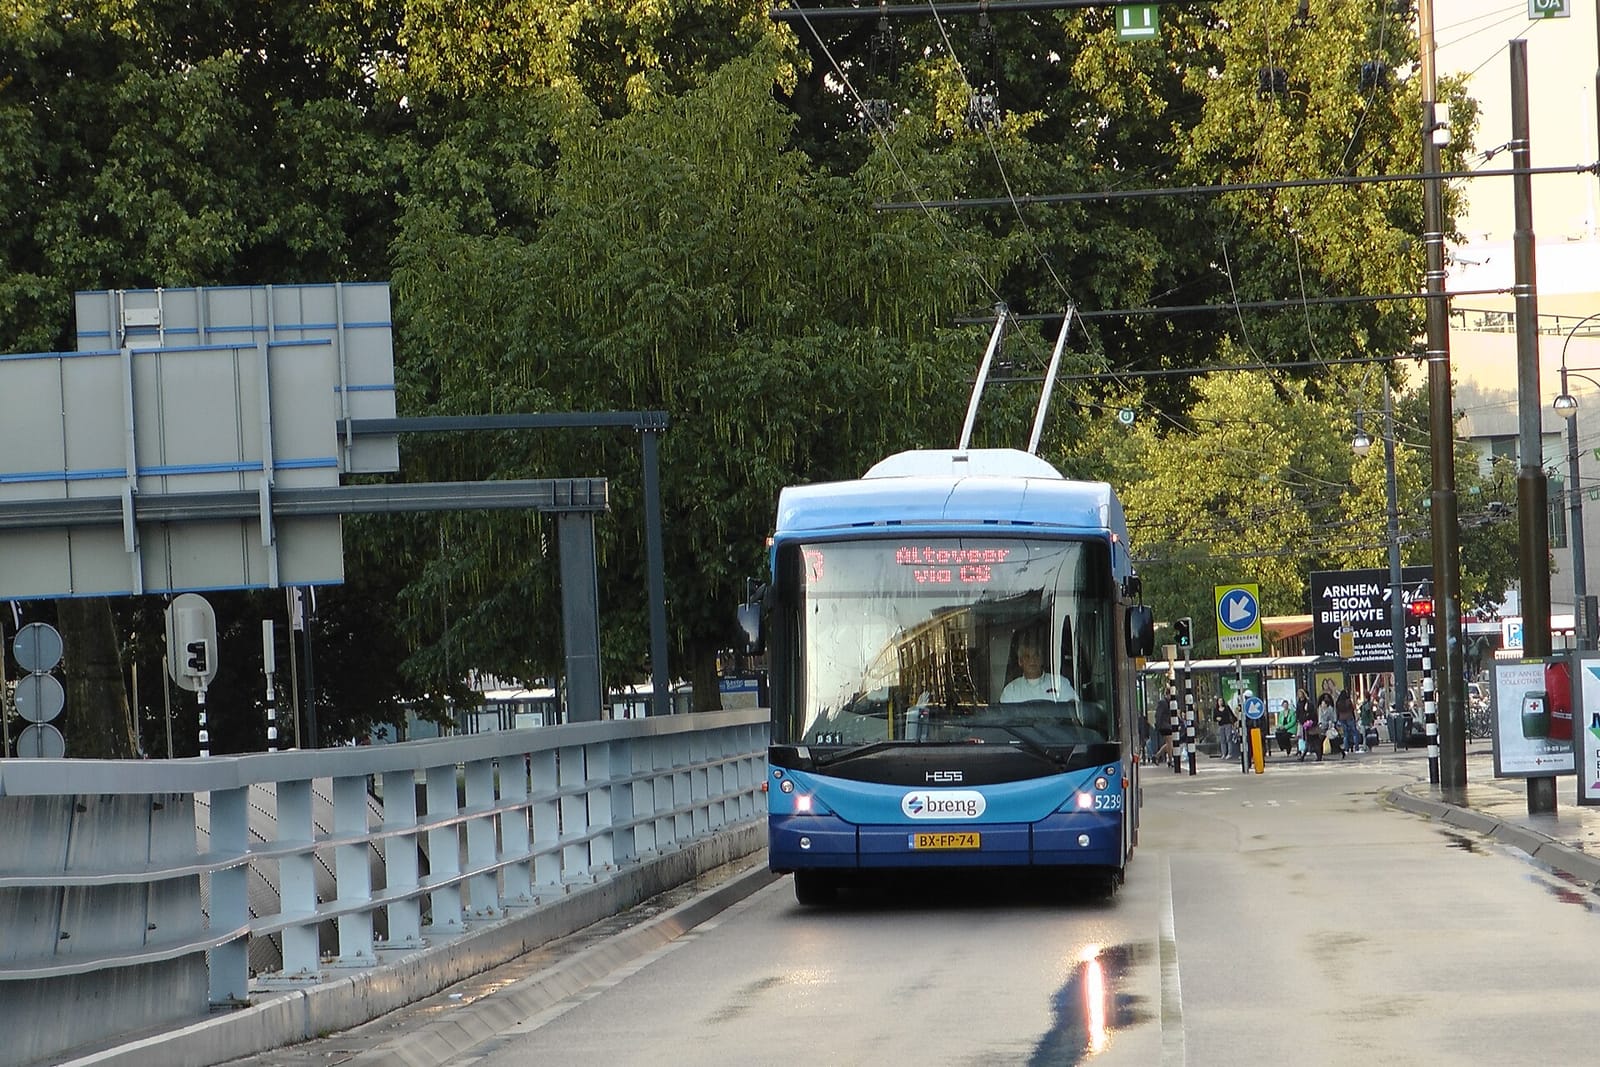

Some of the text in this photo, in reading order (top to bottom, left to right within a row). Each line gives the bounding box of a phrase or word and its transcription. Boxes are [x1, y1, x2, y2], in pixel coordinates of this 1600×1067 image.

[914, 566, 951, 584] via
[1322, 583, 1380, 598] ARNHEM
[1410, 625, 1416, 635] 3
[925, 771, 963, 782] HESS
[926, 795, 977, 816] breng
[1095, 794, 1121, 809] 5239
[919, 834, 974, 847] BX-FP-74
